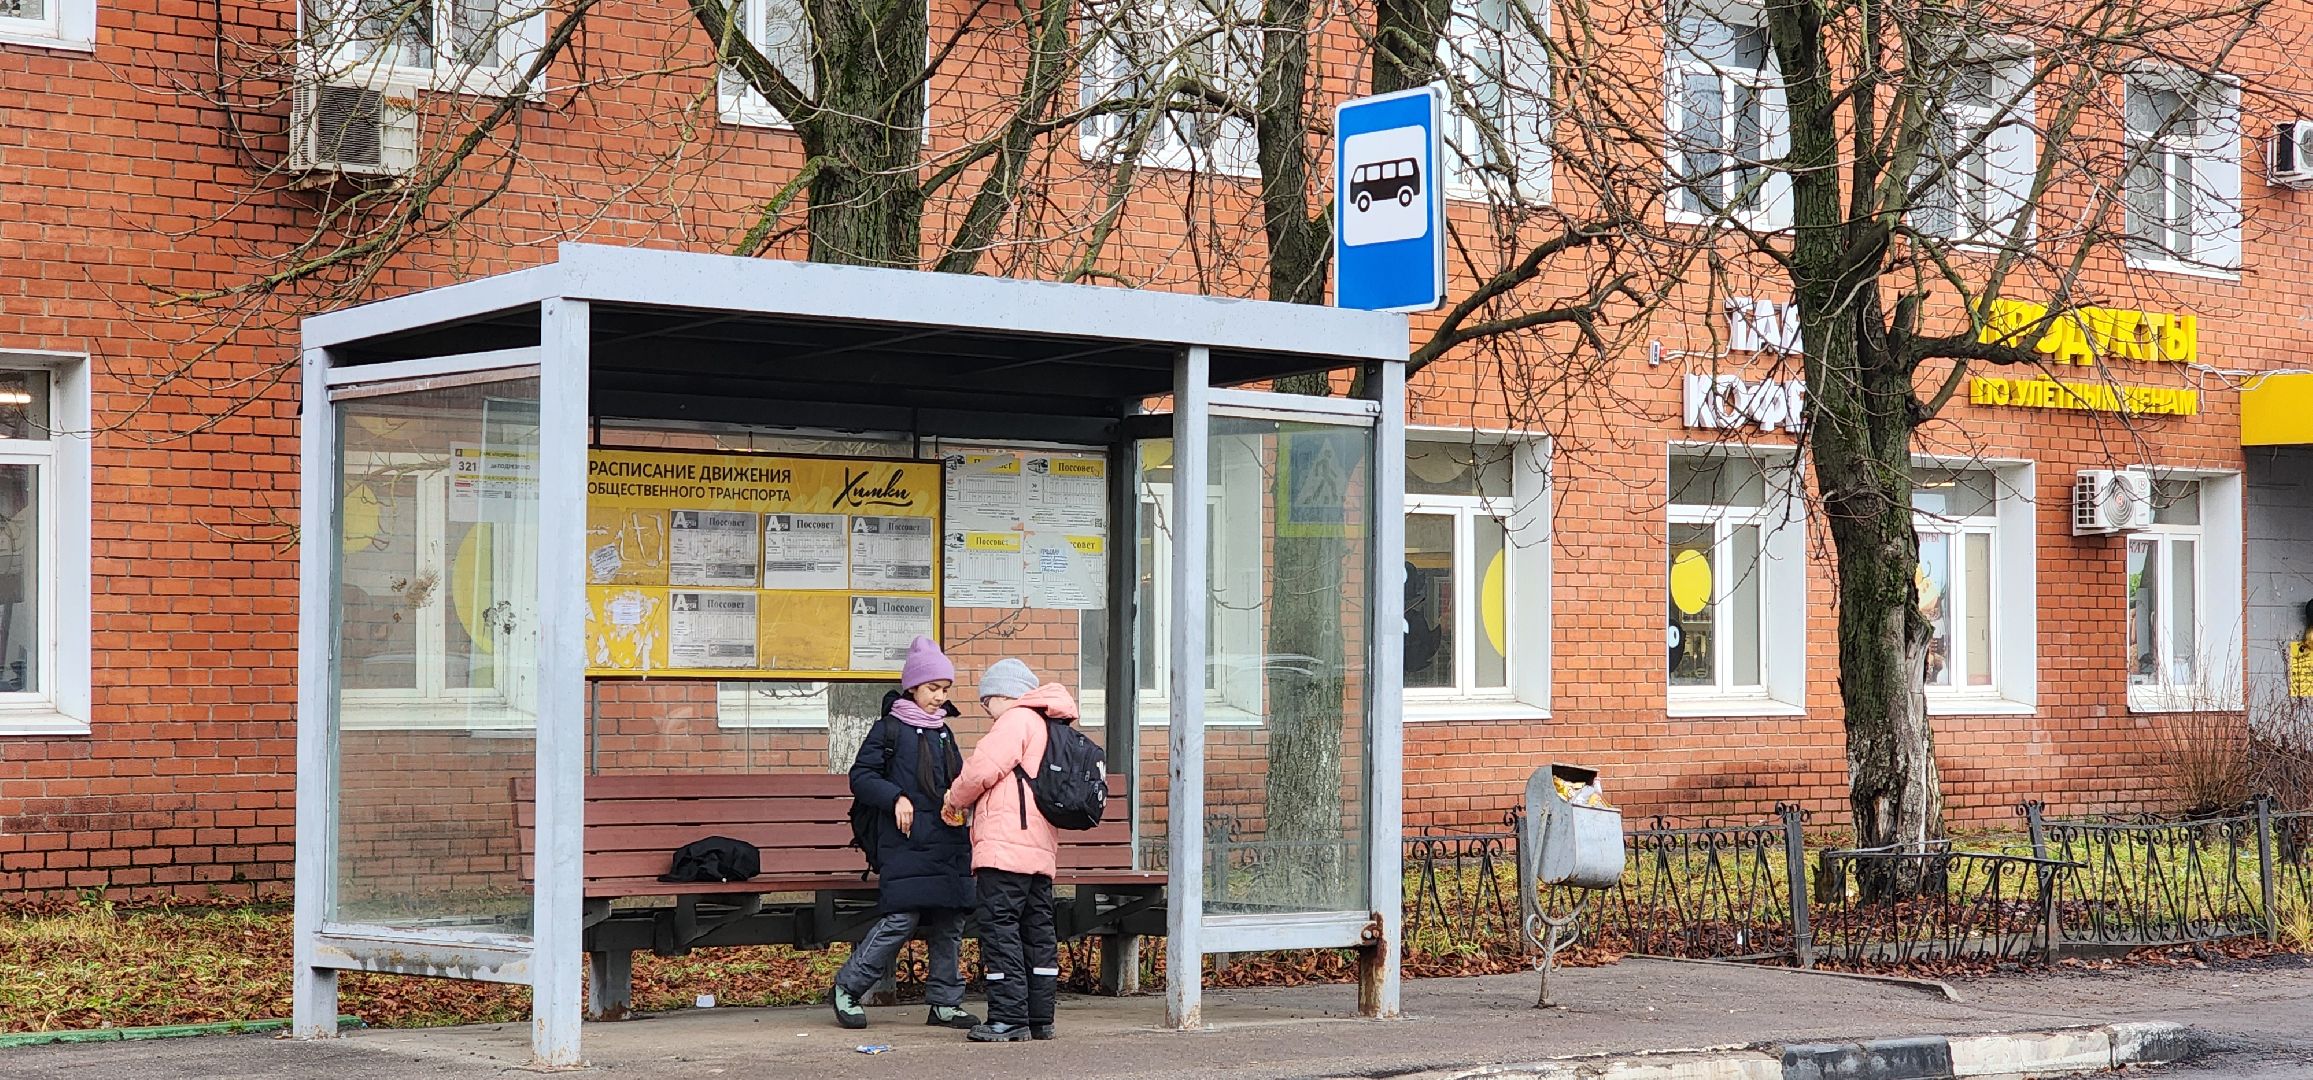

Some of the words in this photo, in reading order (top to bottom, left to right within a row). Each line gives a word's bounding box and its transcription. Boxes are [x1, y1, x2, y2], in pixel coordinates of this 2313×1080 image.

[1971, 297, 2196, 366] ПРОДУКТЫ
[1970, 377, 2009, 406] ПО
[2012, 373, 2121, 412] УЛЁТНЫМ
[458, 461, 477, 471] 321
[588, 460, 696, 480] РАСПИСАНИЕ
[699, 465, 791, 484] ДВИЖЕНИЯ
[587, 482, 705, 499] ОБЩЕСТВЕННОГО
[708, 486, 791, 502] ТРАНСПОРТА
[832, 466, 913, 509] Химки
[796, 519, 835, 530] Поссовет
[976, 536, 1009, 546] Поссове
[707, 599, 745, 609] Поссовет
[882, 602, 924, 613] Поссовет
